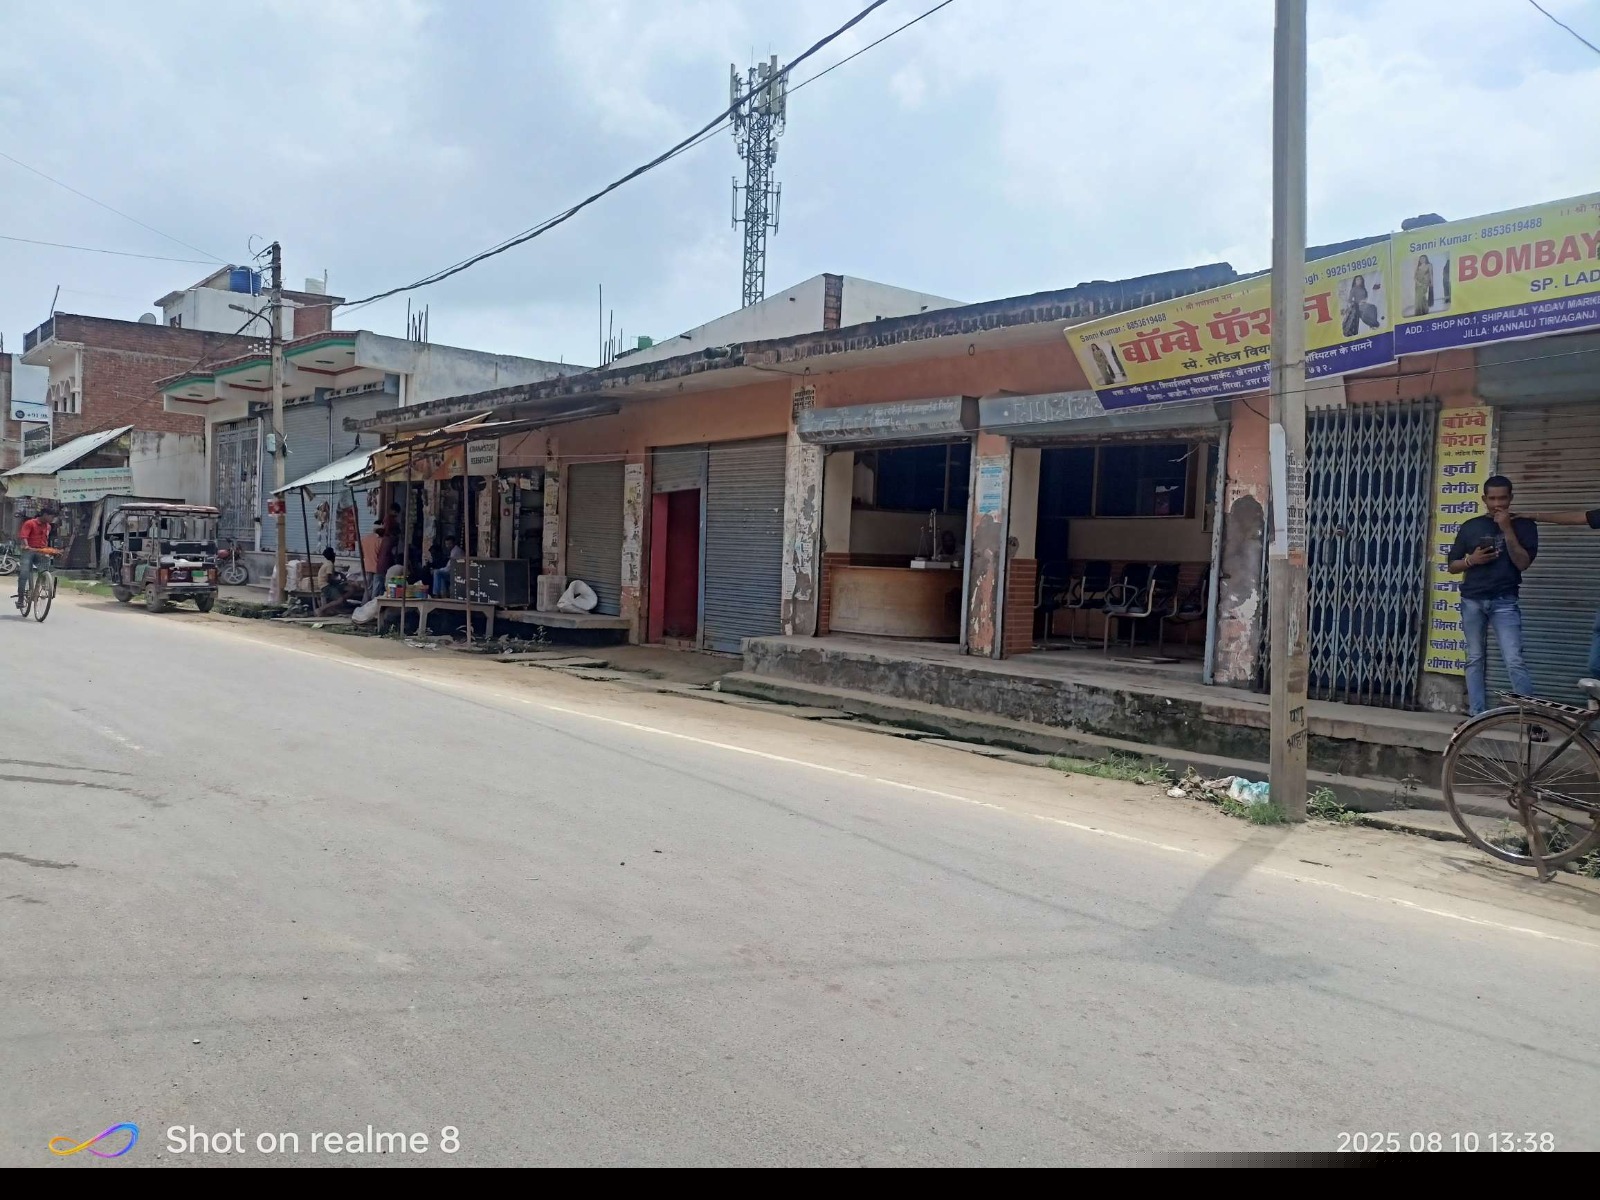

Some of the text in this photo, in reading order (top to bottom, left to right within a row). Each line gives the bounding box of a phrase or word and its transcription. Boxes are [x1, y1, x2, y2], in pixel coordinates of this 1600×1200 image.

[1409, 239, 1437, 253] Sanni
[1439, 233, 1472, 247] Kumar
[1480, 217, 1543, 239] 8853619488
[1458, 230, 1600, 283] BOMBAY
[1326, 256, 1378, 278] 9926198902
[1530, 277, 1558, 293] SP.
[1431, 320, 1455, 331] SHOP
[1481, 307, 1530, 323] SHIPAILAL
[1531, 301, 1566, 315] YADAV
[1492, 318, 1537, 333] KANNAUJ
[1080, 333, 1099, 343] Sanni
[1100, 326, 1122, 337] Kumar
[1119, 319, 1204, 364] बॉम्बे
[1338, 345, 1348, 355] के
[1350, 340, 1373, 352] सामने
[1205, 351, 1241, 366] लेडिज
